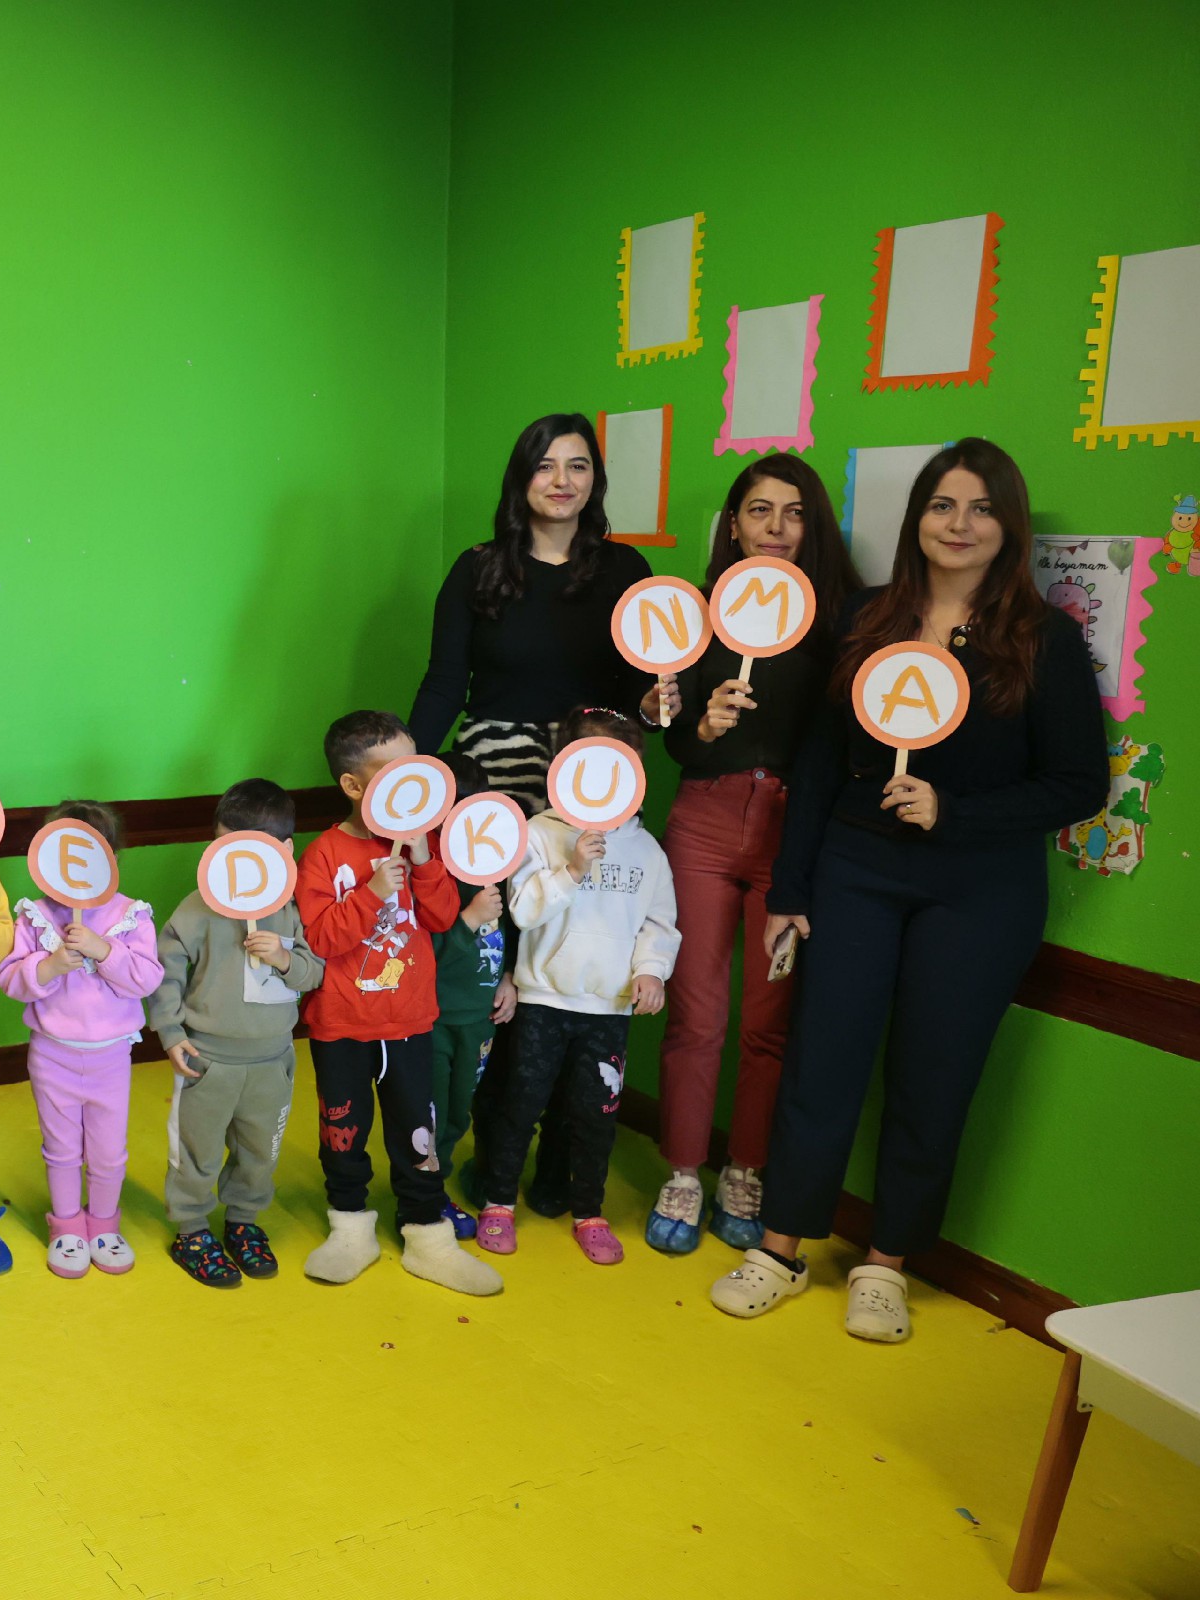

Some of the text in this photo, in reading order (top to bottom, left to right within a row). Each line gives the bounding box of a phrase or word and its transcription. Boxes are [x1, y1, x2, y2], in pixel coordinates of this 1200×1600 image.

[639, 592, 689, 654] N
[725, 576, 789, 641] M
[880, 664, 941, 726] A
[384, 774, 430, 820] O
[572, 759, 620, 808] U
[59, 833, 95, 890] E
[464, 811, 505, 867] K
[225, 849, 268, 902] D
